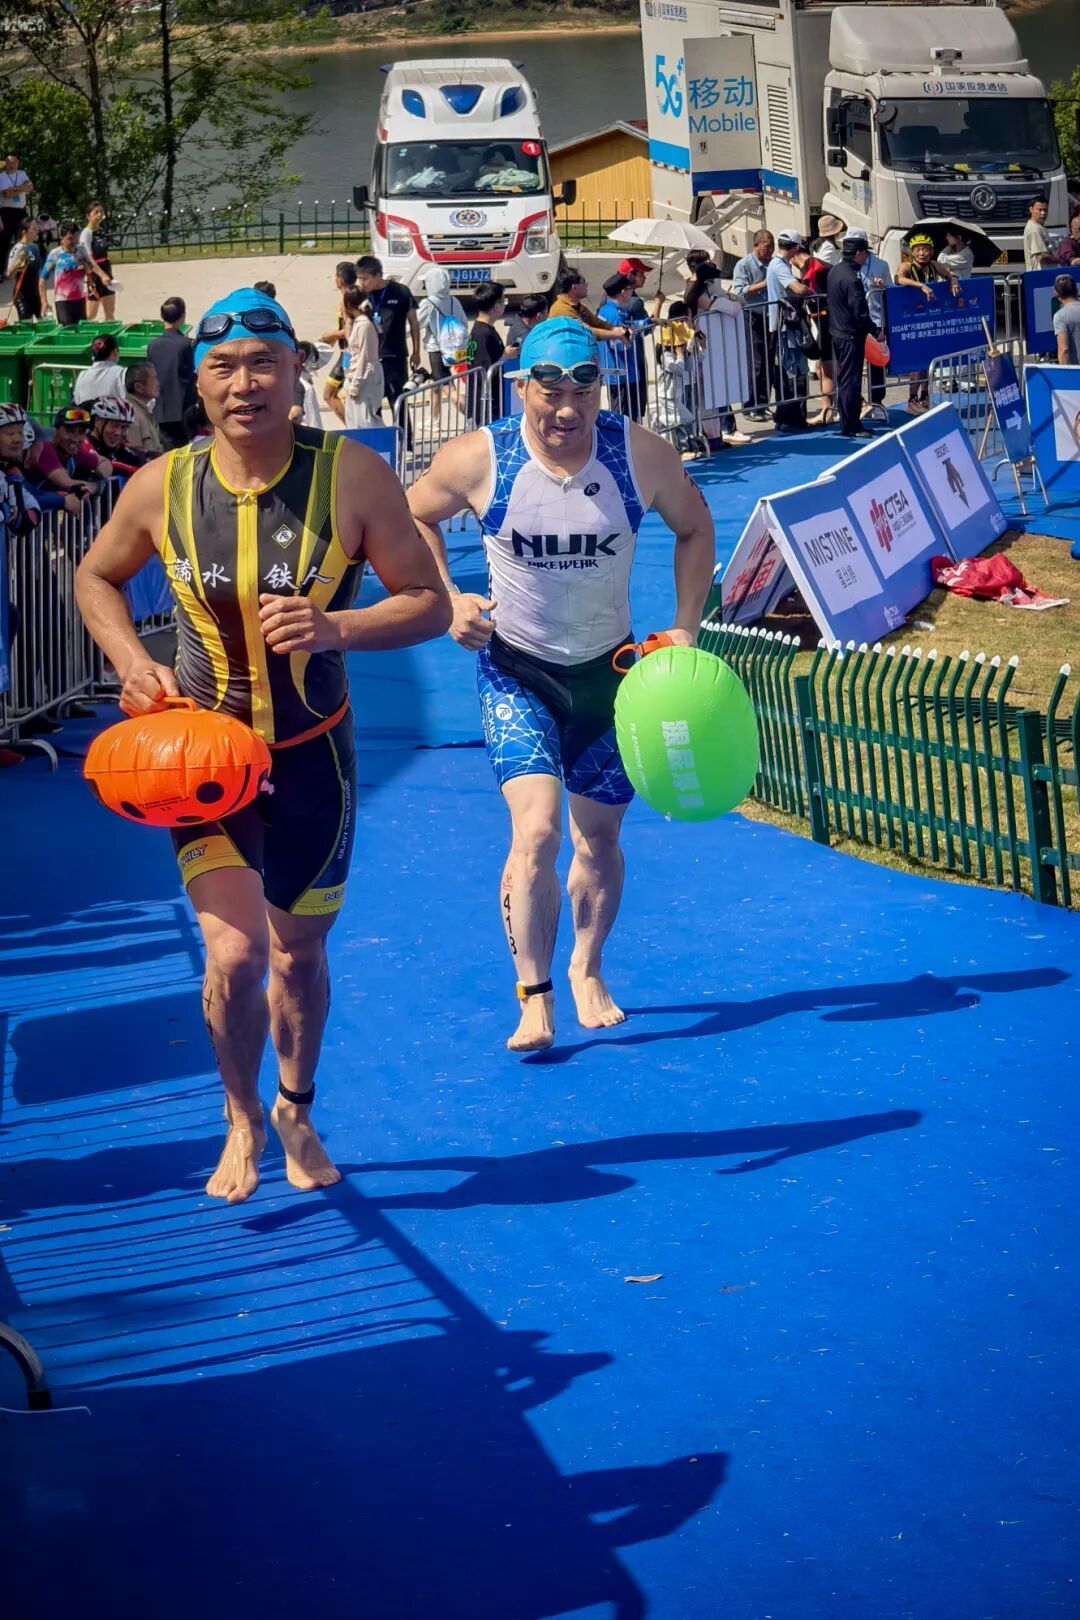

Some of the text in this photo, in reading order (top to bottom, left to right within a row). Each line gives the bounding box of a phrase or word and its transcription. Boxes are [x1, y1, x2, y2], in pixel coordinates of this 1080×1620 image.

[688, 75, 754, 110] 移动
[944, 81, 1008, 92] 国家应急通信
[689, 112, 756, 134] Mobile
[527, 142, 536, 154] 1
[883, 489, 911, 520] CTSA
[511, 528, 621, 558] NUK
[803, 526, 858, 568] MISTINE
[263, 561, 335, 591] 铁人
